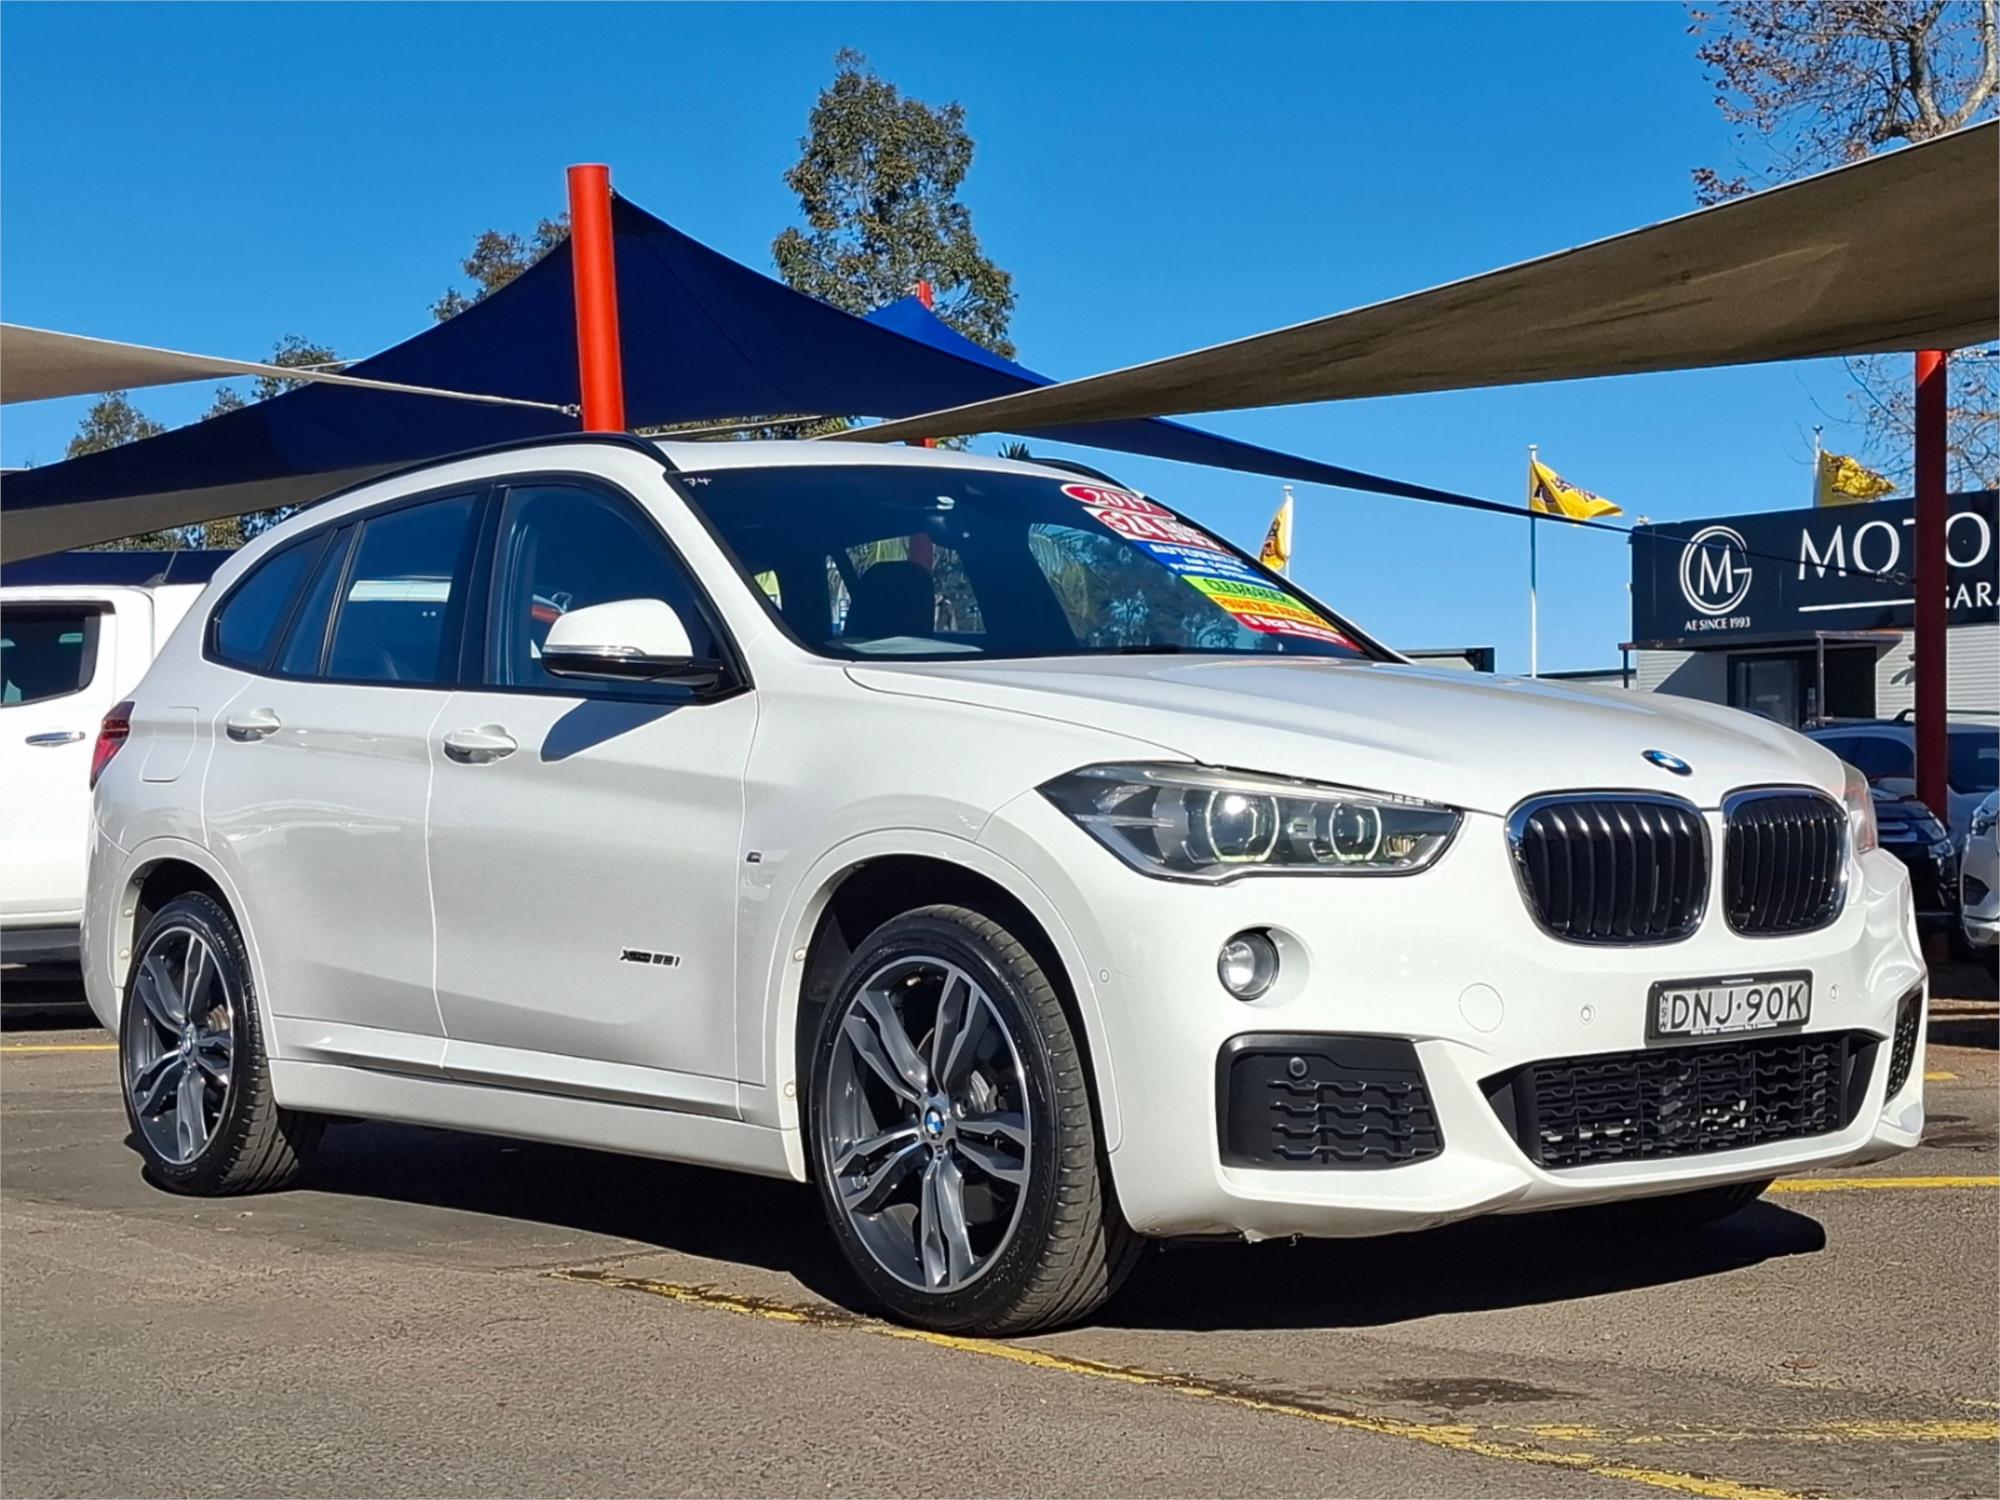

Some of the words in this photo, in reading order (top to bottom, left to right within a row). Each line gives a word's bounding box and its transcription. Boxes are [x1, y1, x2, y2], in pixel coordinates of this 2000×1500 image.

[1083, 488, 1152, 513] 2017
[1799, 511, 1990, 581] MOO
[1699, 617, 1728, 630] SINCE
[1730, 615, 1751, 628] 1993
